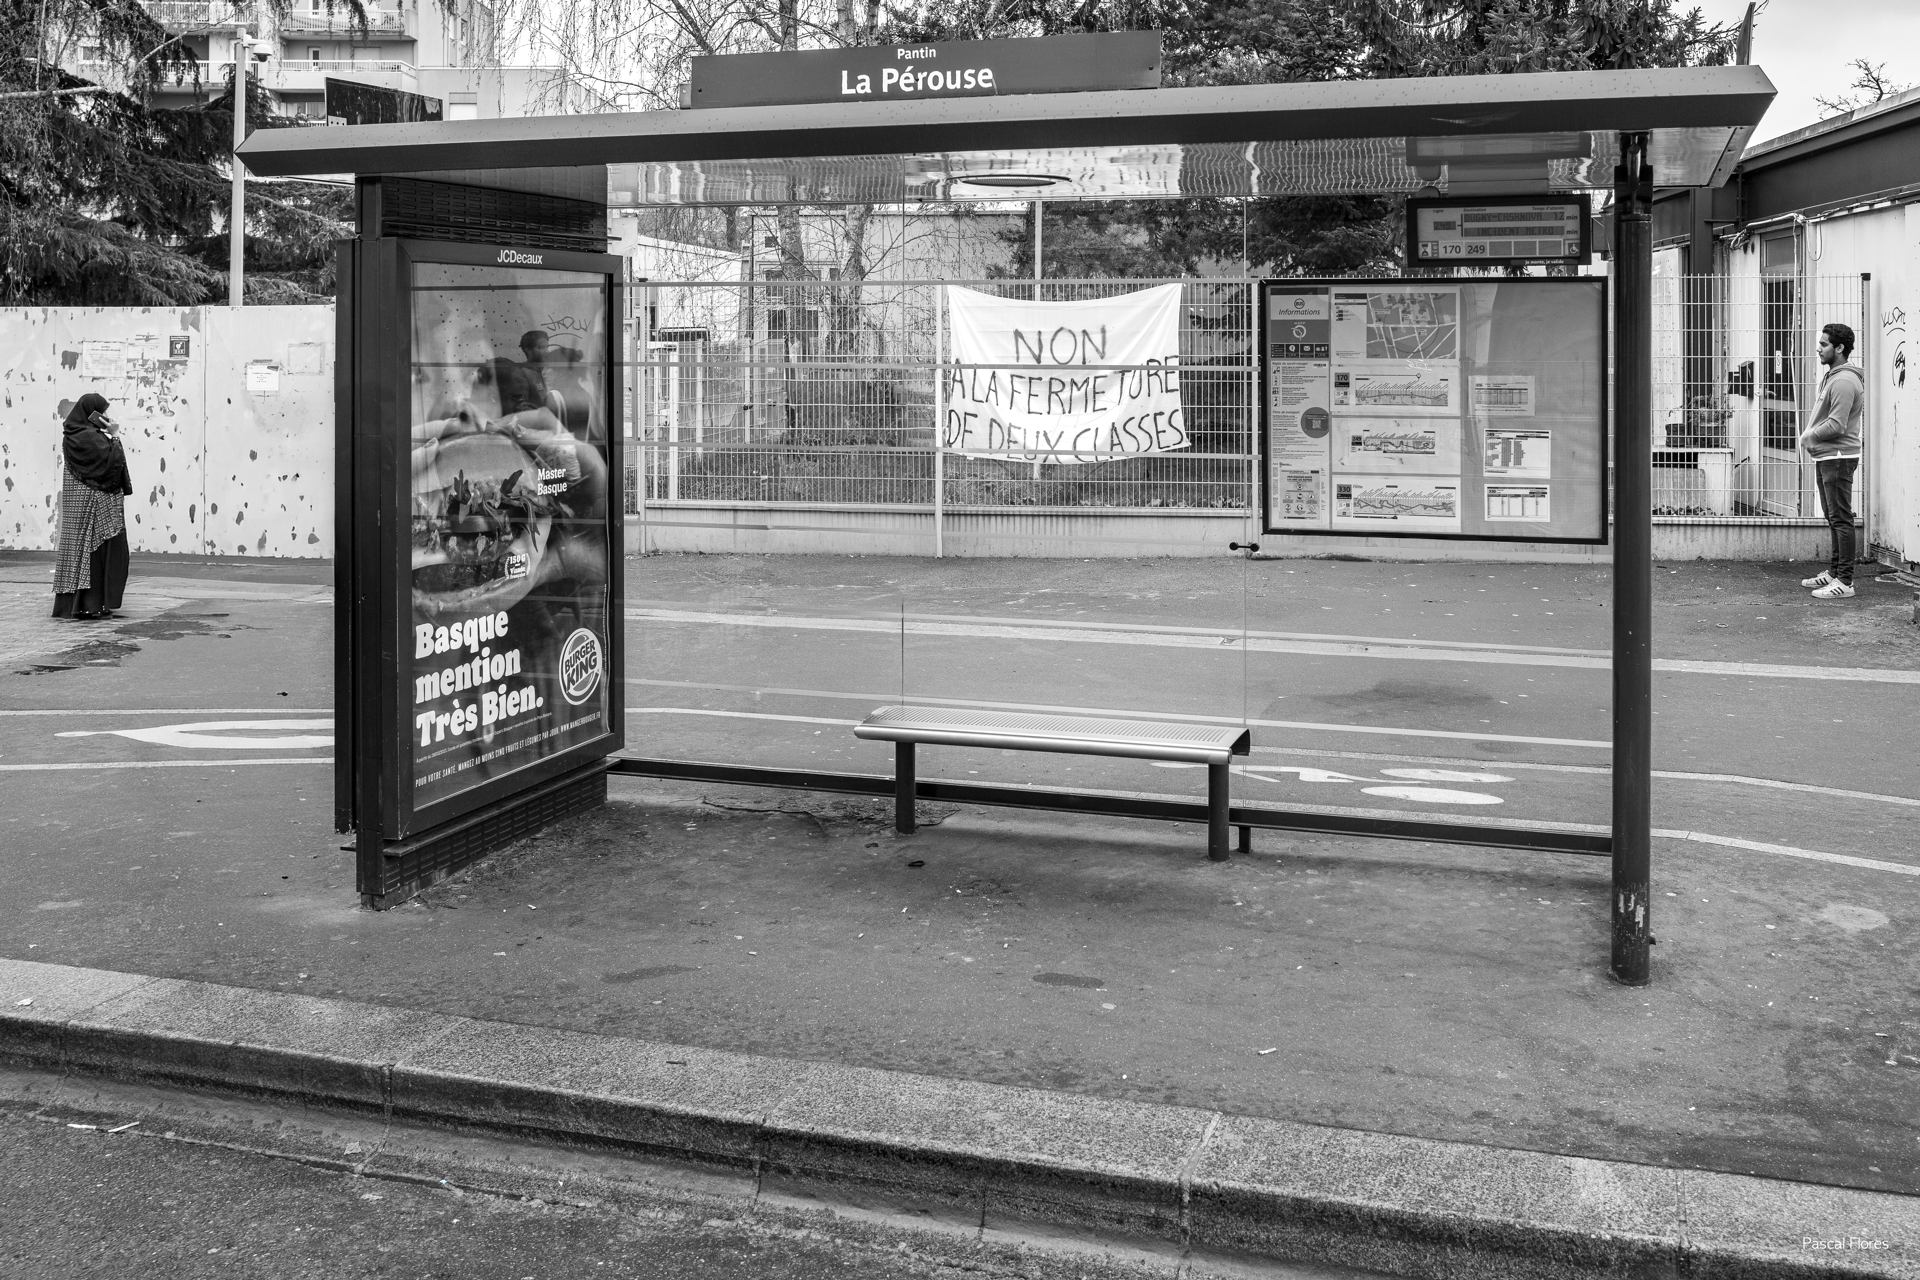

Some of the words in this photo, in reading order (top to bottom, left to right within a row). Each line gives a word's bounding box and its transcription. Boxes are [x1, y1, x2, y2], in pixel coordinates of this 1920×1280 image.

[897, 46, 937, 60] Pantin
[841, 70, 872, 95] La
[882, 66, 993, 93] Pérouse
[497, 249, 543, 265] JCDecaux
[1442, 244, 1461, 254] 170
[1467, 244, 1486, 254] 249
[1278, 308, 1321, 316] Informations
[1012, 323, 1107, 365] NON
[951, 358, 966, 400] A
[971, 363, 999, 406] LA
[988, 417, 1064, 464] DEUX
[1072, 409, 1184, 463] CLASSES
[537, 467, 567, 481] Master
[537, 482, 568, 497] Basque
[510, 554, 521, 564] 150
[415, 610, 509, 660] Basque
[415, 646, 522, 704] mention
[564, 639, 596, 675] BURGER
[566, 651, 598, 693] KING
[416, 698, 478, 747] Très
[481, 683, 544, 726] Bien.
[415, 775, 427, 788] POUR
[427, 770, 442, 783] VOTRE
[458, 758, 475, 772] MANGEZ
[475, 756, 481, 765] AU
[481, 751, 495, 763] MOINS
[495, 747, 505, 758] CINQ
[505, 741, 519, 754] FRUITS
[519, 739, 525, 749] ET
[525, 733, 542, 747] LÉGUMES
